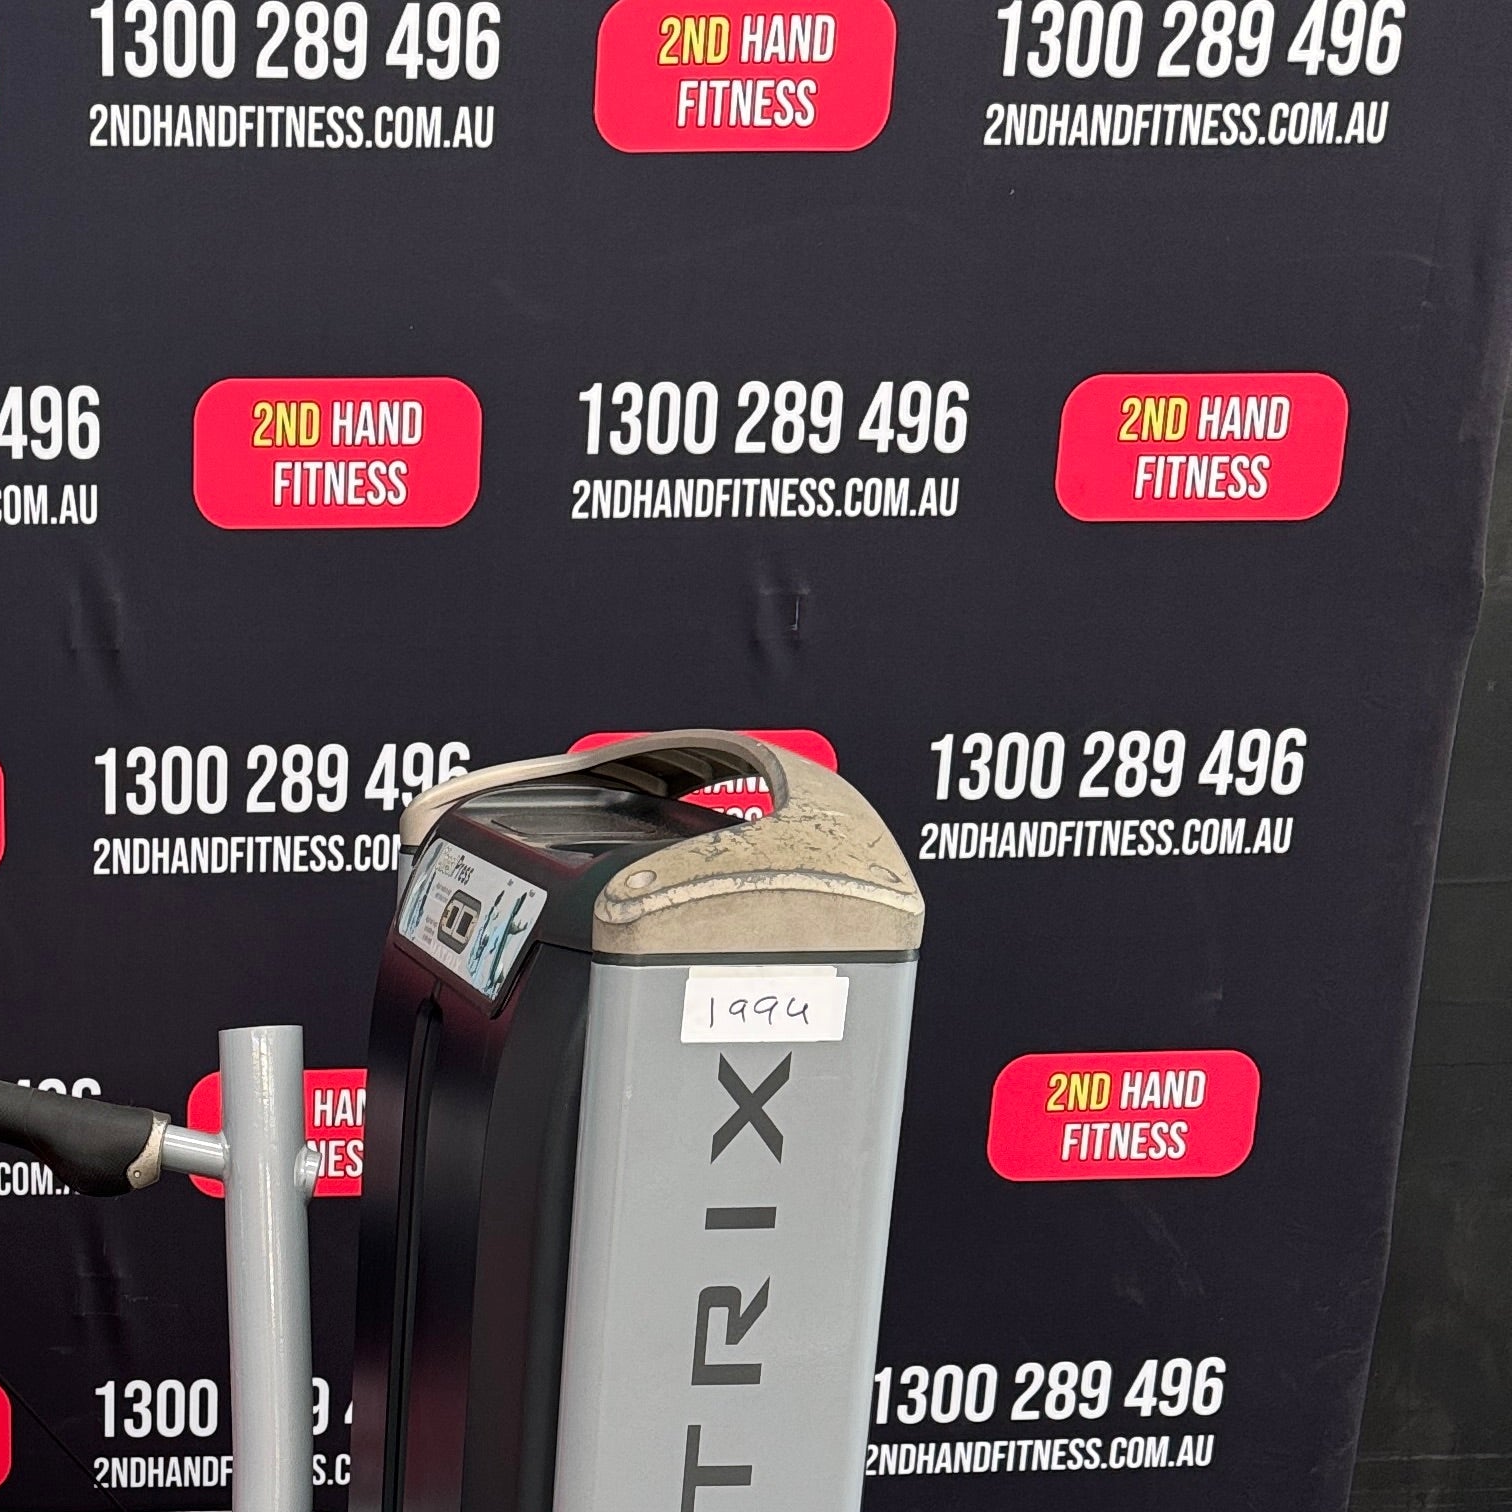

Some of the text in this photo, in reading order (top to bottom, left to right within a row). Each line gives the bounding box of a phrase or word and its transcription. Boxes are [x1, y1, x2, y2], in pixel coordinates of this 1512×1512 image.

[90, 0, 501, 81] 1300 289 496
[659, 14, 836, 65] 2ND HAND
[997, 0, 1406, 79] 1300 289 496
[89, 103, 495, 149] 2NDHANDFITNESS.COM.AU
[677, 79, 817, 127] FITNESS
[983, 100, 1390, 147] 2NDHANDFITNESS.COM.AU
[253, 401, 423, 447] 2ND HAND
[578, 380, 970, 456] 1300 289 496
[1119, 396, 1290, 441] 2ND HAND
[274, 460, 408, 506] FITNESS
[571, 477, 960, 520] 2NDHANDFITNESS.COM.AU
[1134, 454, 1270, 499] FITNESS
[94, 745, 228, 816] 1300
[246, 743, 349, 813] 289
[930, 727, 1307, 801] 1300 289 496
[918, 817, 1294, 860] 2NDHANDFITNESS.COM.AU
[1046, 1070, 1206, 1111] 2ND HAND
[1061, 1121, 1188, 1161] FITNESS
[95, 1378, 219, 1438] 1300
[874, 1356, 1227, 1425] 1300 289 496
[865, 1434, 1216, 1476] 2NDHANDFITNESS.COM.AU
